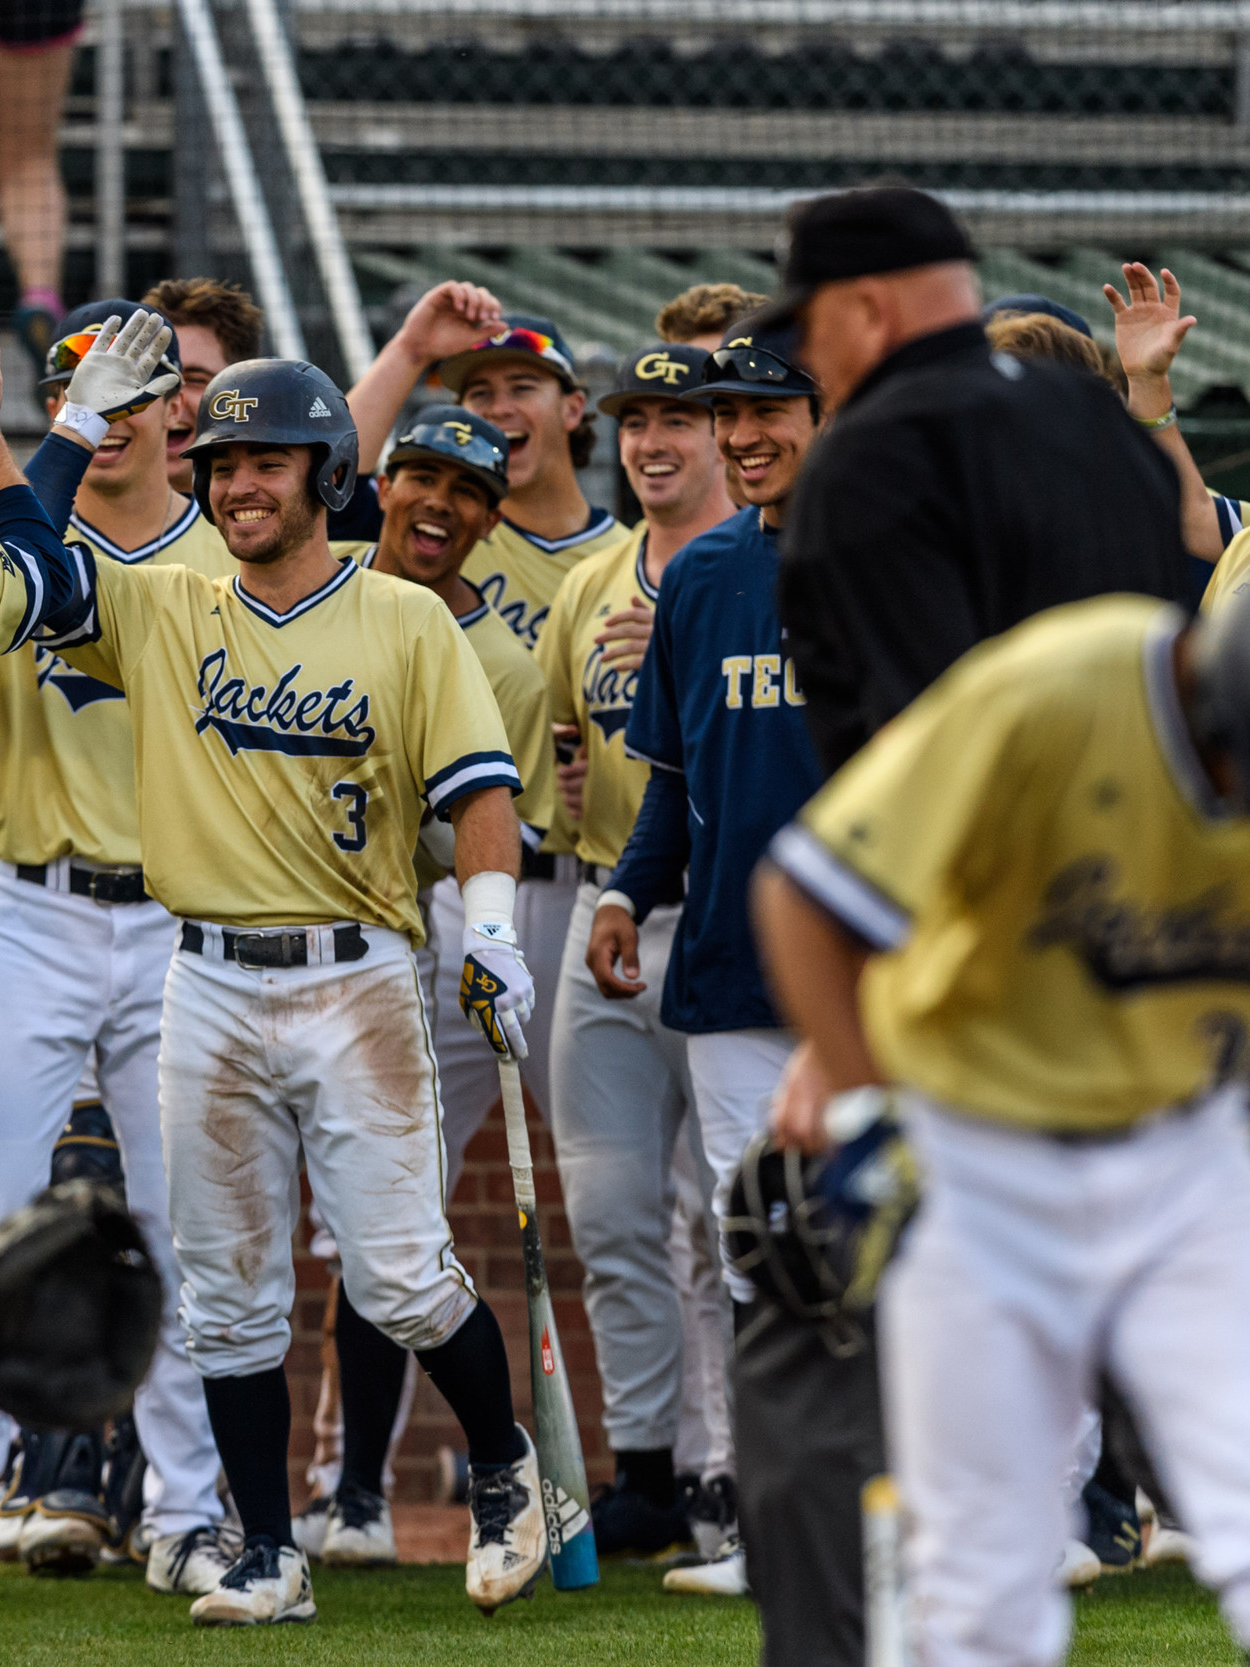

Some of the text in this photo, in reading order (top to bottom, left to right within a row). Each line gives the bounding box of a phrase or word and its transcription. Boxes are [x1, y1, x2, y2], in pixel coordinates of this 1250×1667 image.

[635, 352, 690, 385] GT
[209, 389, 258, 422] GT
[195, 648, 372, 739] Jackets
[331, 780, 368, 852] 3
[542, 1478, 561, 1554] adidas
